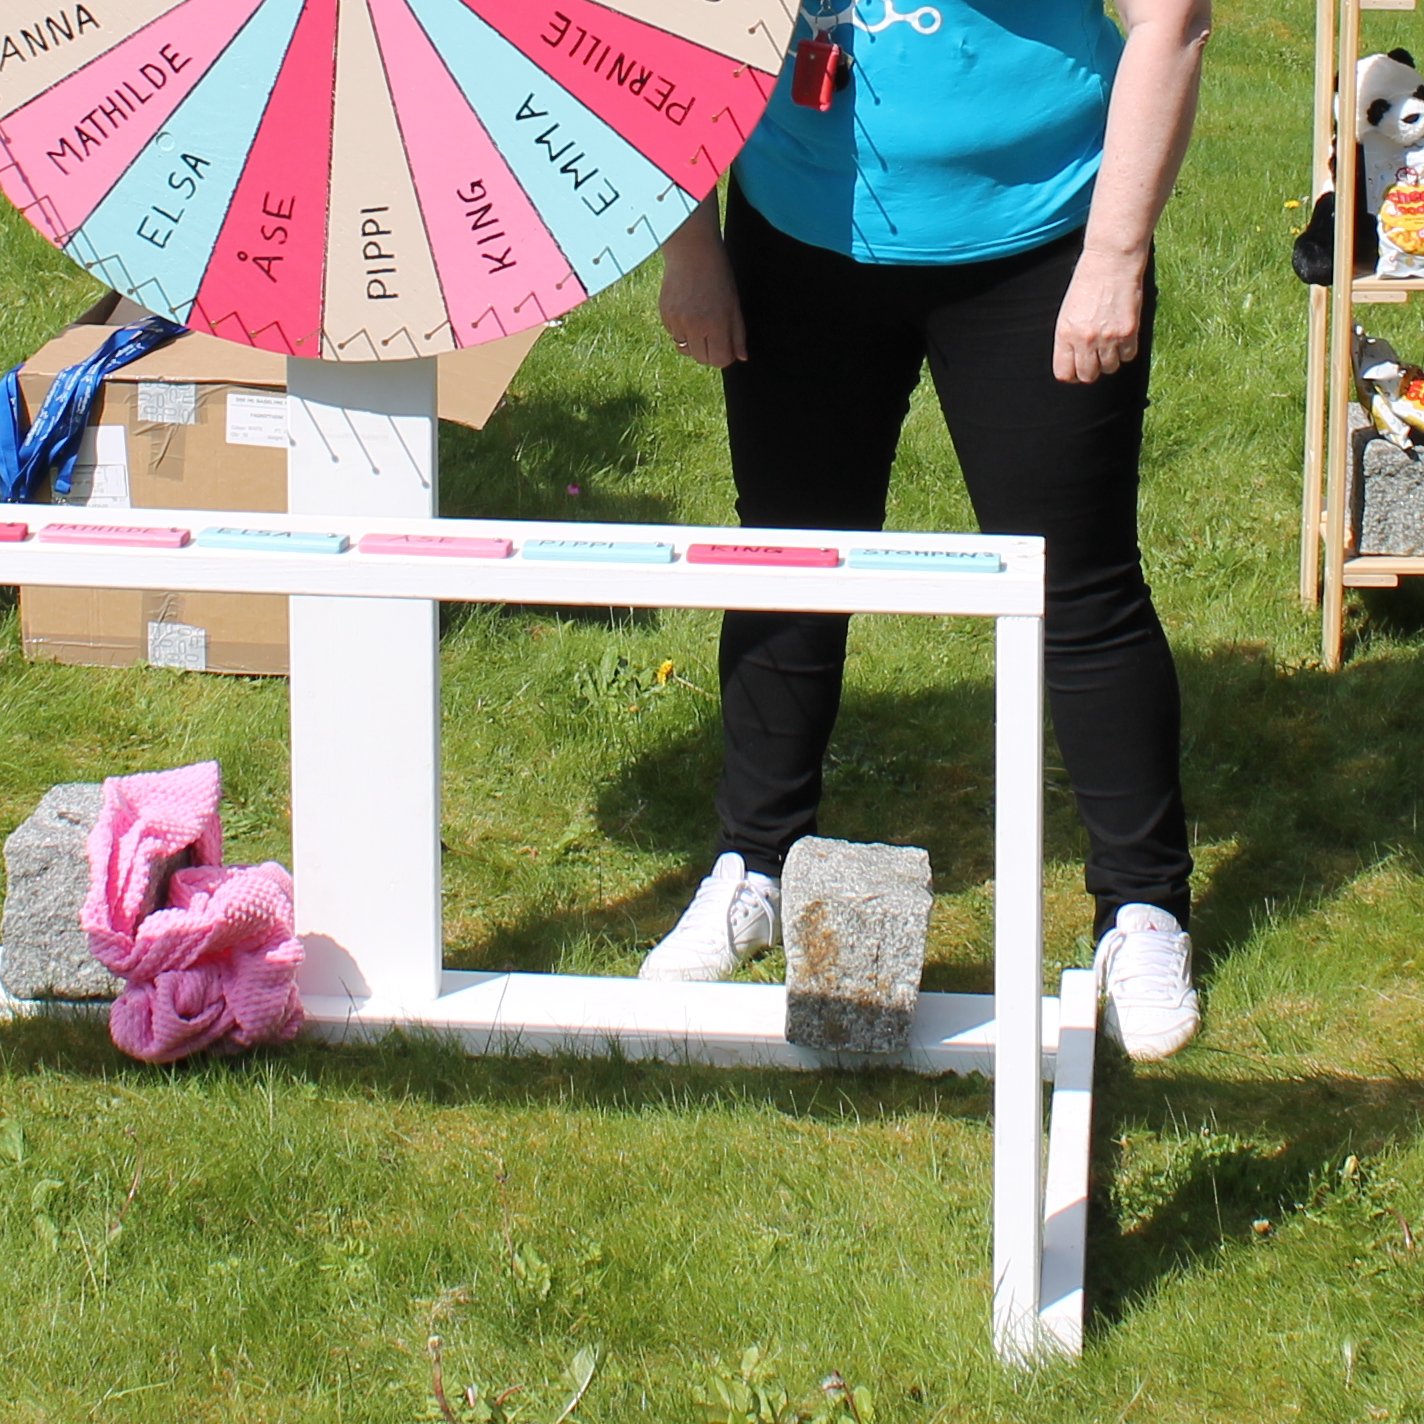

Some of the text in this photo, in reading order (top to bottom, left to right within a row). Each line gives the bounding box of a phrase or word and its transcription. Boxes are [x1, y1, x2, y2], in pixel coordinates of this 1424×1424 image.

[46, 43, 193, 175] MATHILDE
[540, 11, 695, 126] PERNILLE
[136, 152, 212, 248] ELSA
[514, 93, 620, 216] EMMA
[237, 191, 295, 283] ÅSE
[360, 206, 399, 300] PIPPI
[457, 179, 518, 275] KING
[45, 523, 157, 534] MATHILDE
[217, 527, 292, 538] ELSA
[538, 539, 616, 549] PIPPI
[710, 544, 784, 554] KING
[862, 548, 979, 559] STOMPEN
